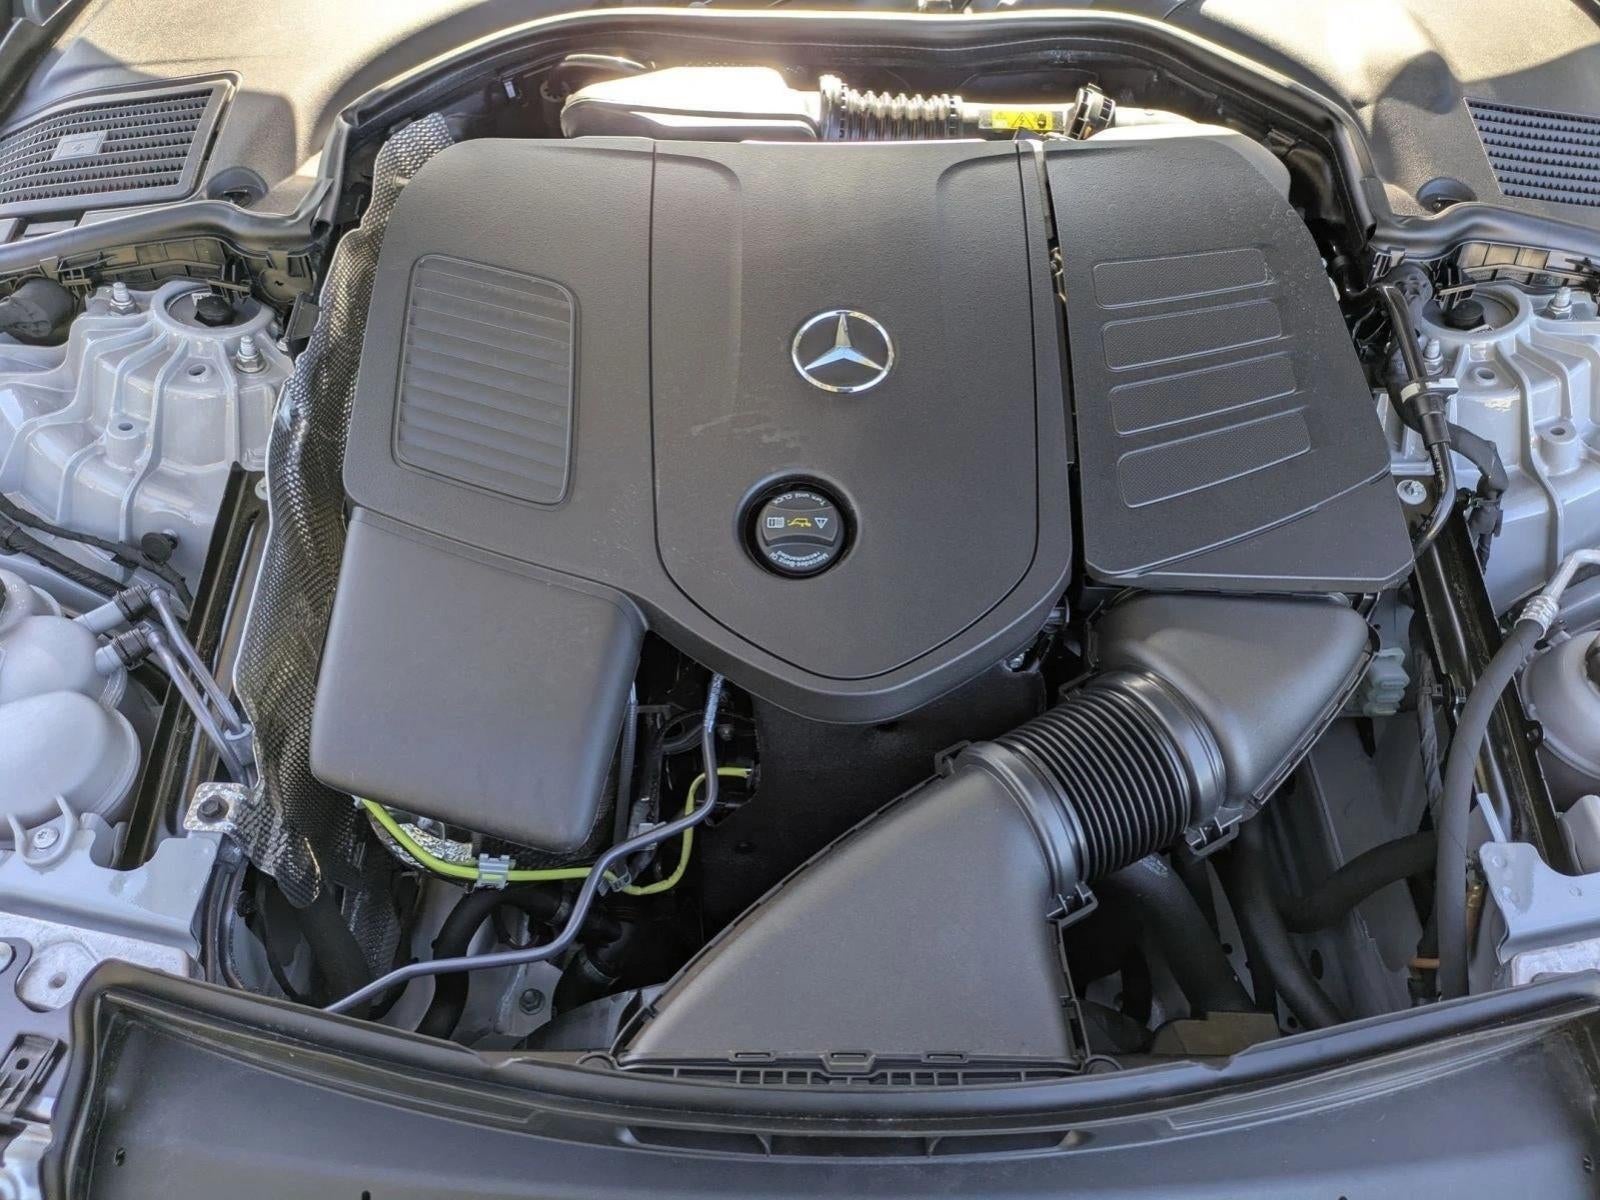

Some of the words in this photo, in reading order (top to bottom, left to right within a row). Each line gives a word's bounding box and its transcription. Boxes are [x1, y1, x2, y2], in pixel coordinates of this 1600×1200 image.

[773, 494, 793, 504] CLICK
[811, 495, 826, 506] Turn
[777, 550, 820, 561] recommended
[778, 553, 829, 567] Mercedes-Benz
